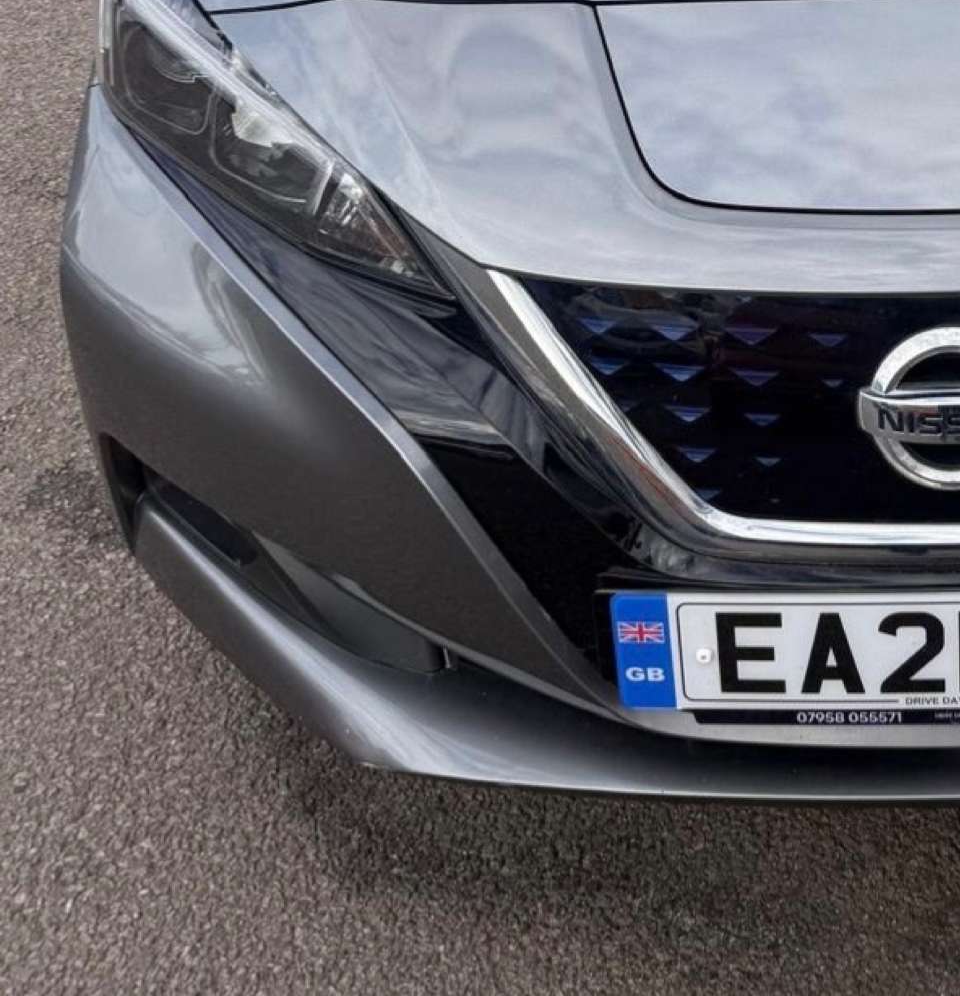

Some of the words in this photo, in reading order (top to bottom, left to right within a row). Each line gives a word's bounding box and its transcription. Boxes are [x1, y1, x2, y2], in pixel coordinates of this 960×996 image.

[625, 667, 665, 683] GB
[905, 696, 939, 705] DRIVE
[796, 711, 845, 724] 07958
[848, 711, 902, 724] 055571
